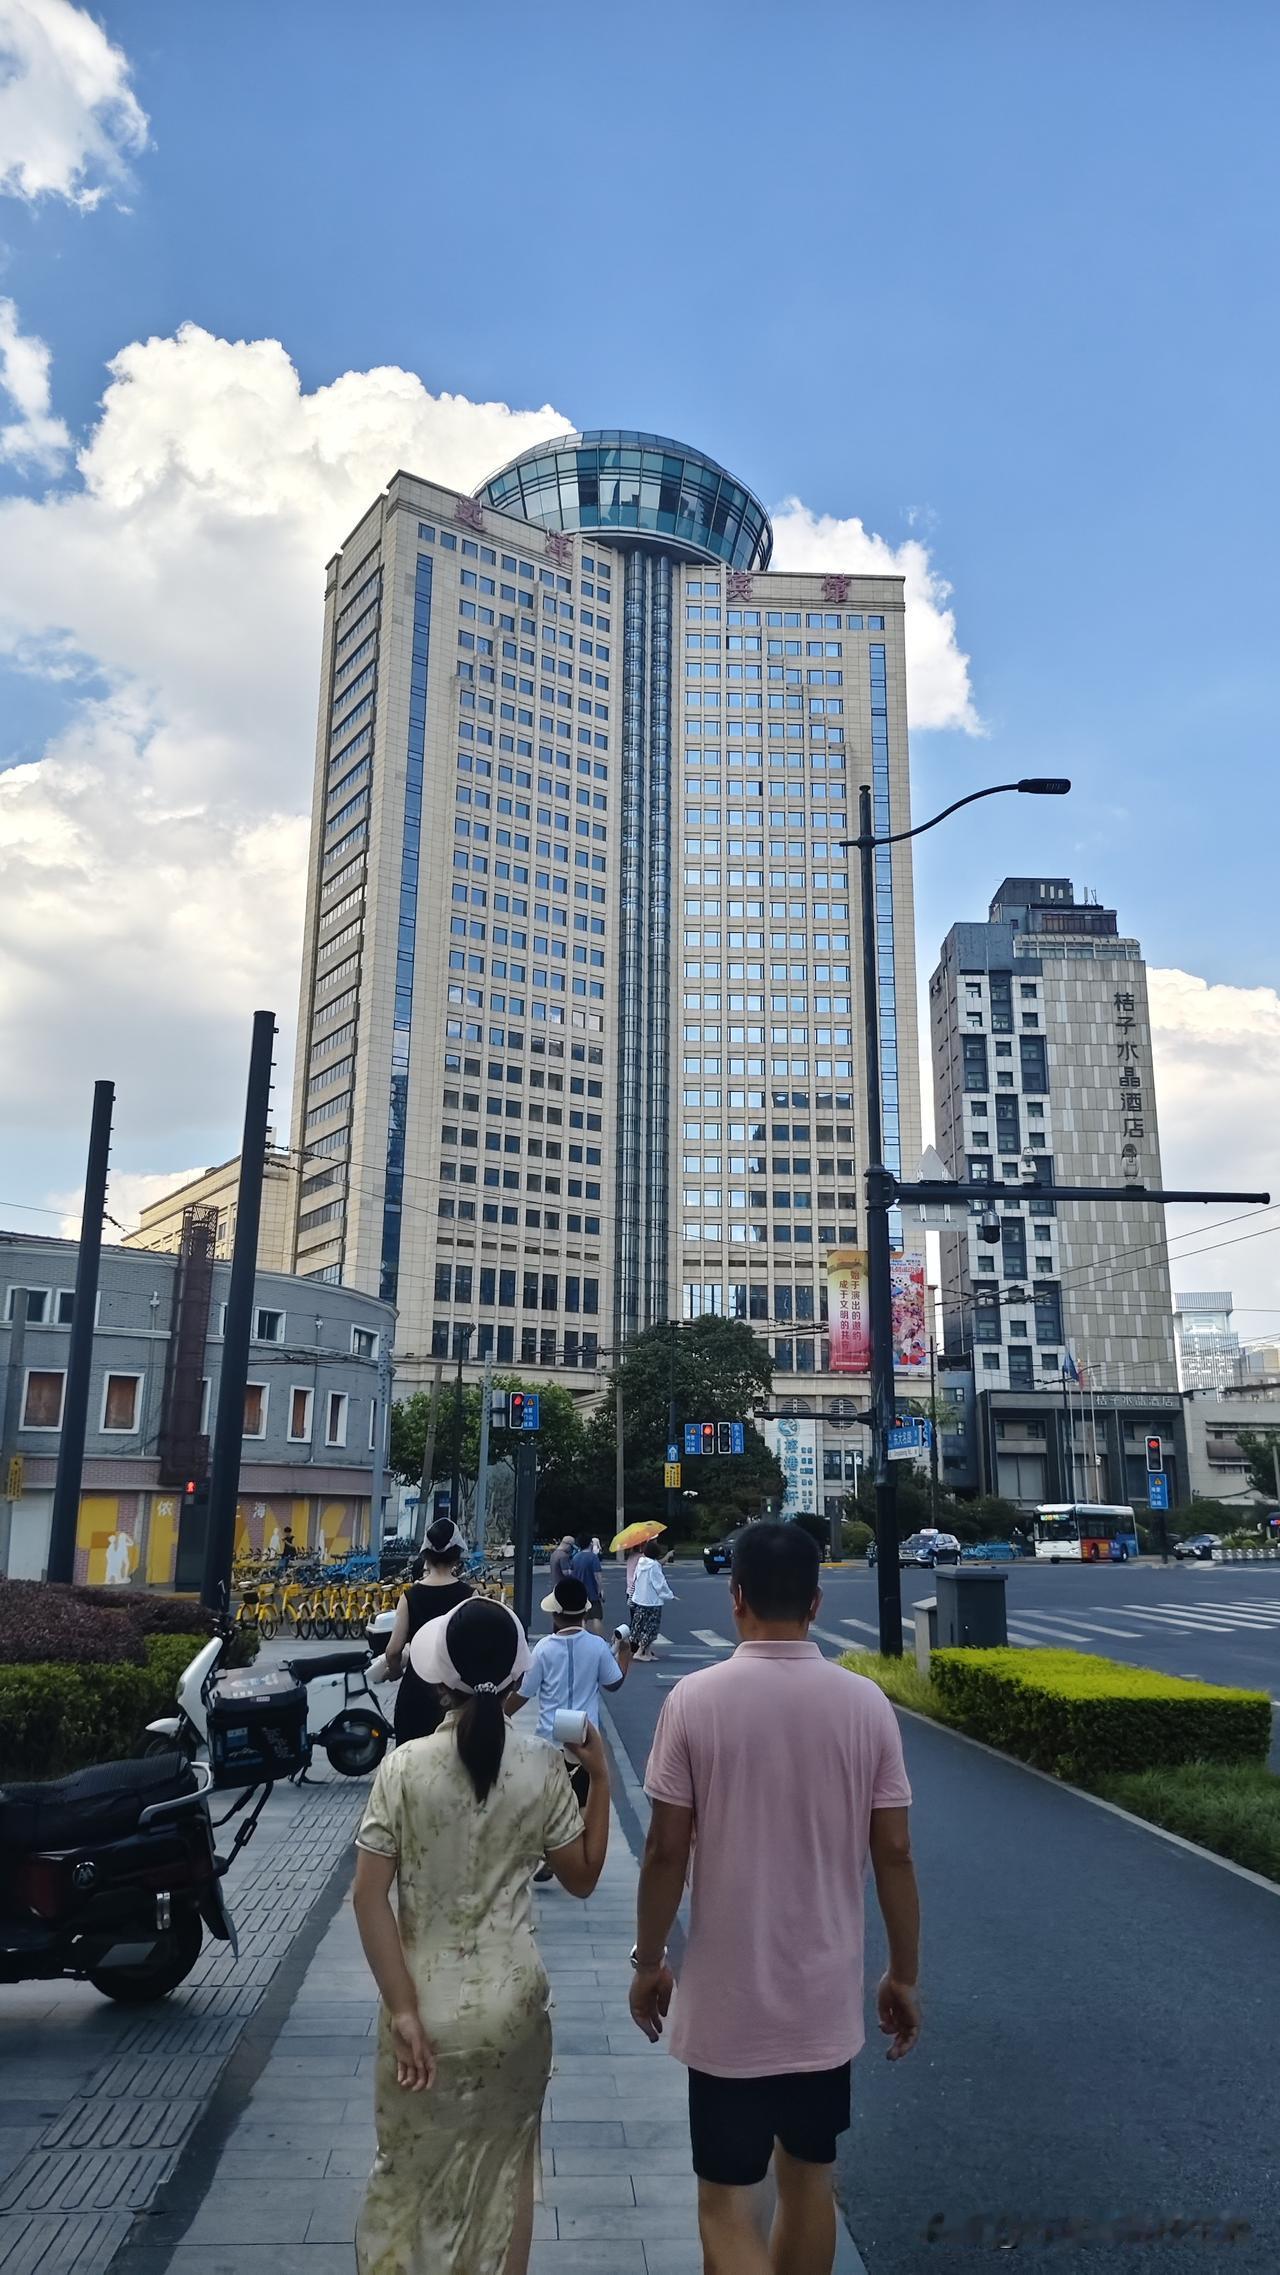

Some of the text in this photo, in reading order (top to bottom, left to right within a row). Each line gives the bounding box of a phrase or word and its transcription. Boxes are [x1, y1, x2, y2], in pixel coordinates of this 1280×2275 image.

[725, 570, 852, 604] 宾馆
[1113, 991, 1145, 1139] 桔子水晶酒店
[1096, 1395, 1173, 1407] 桔子水晶酒店
